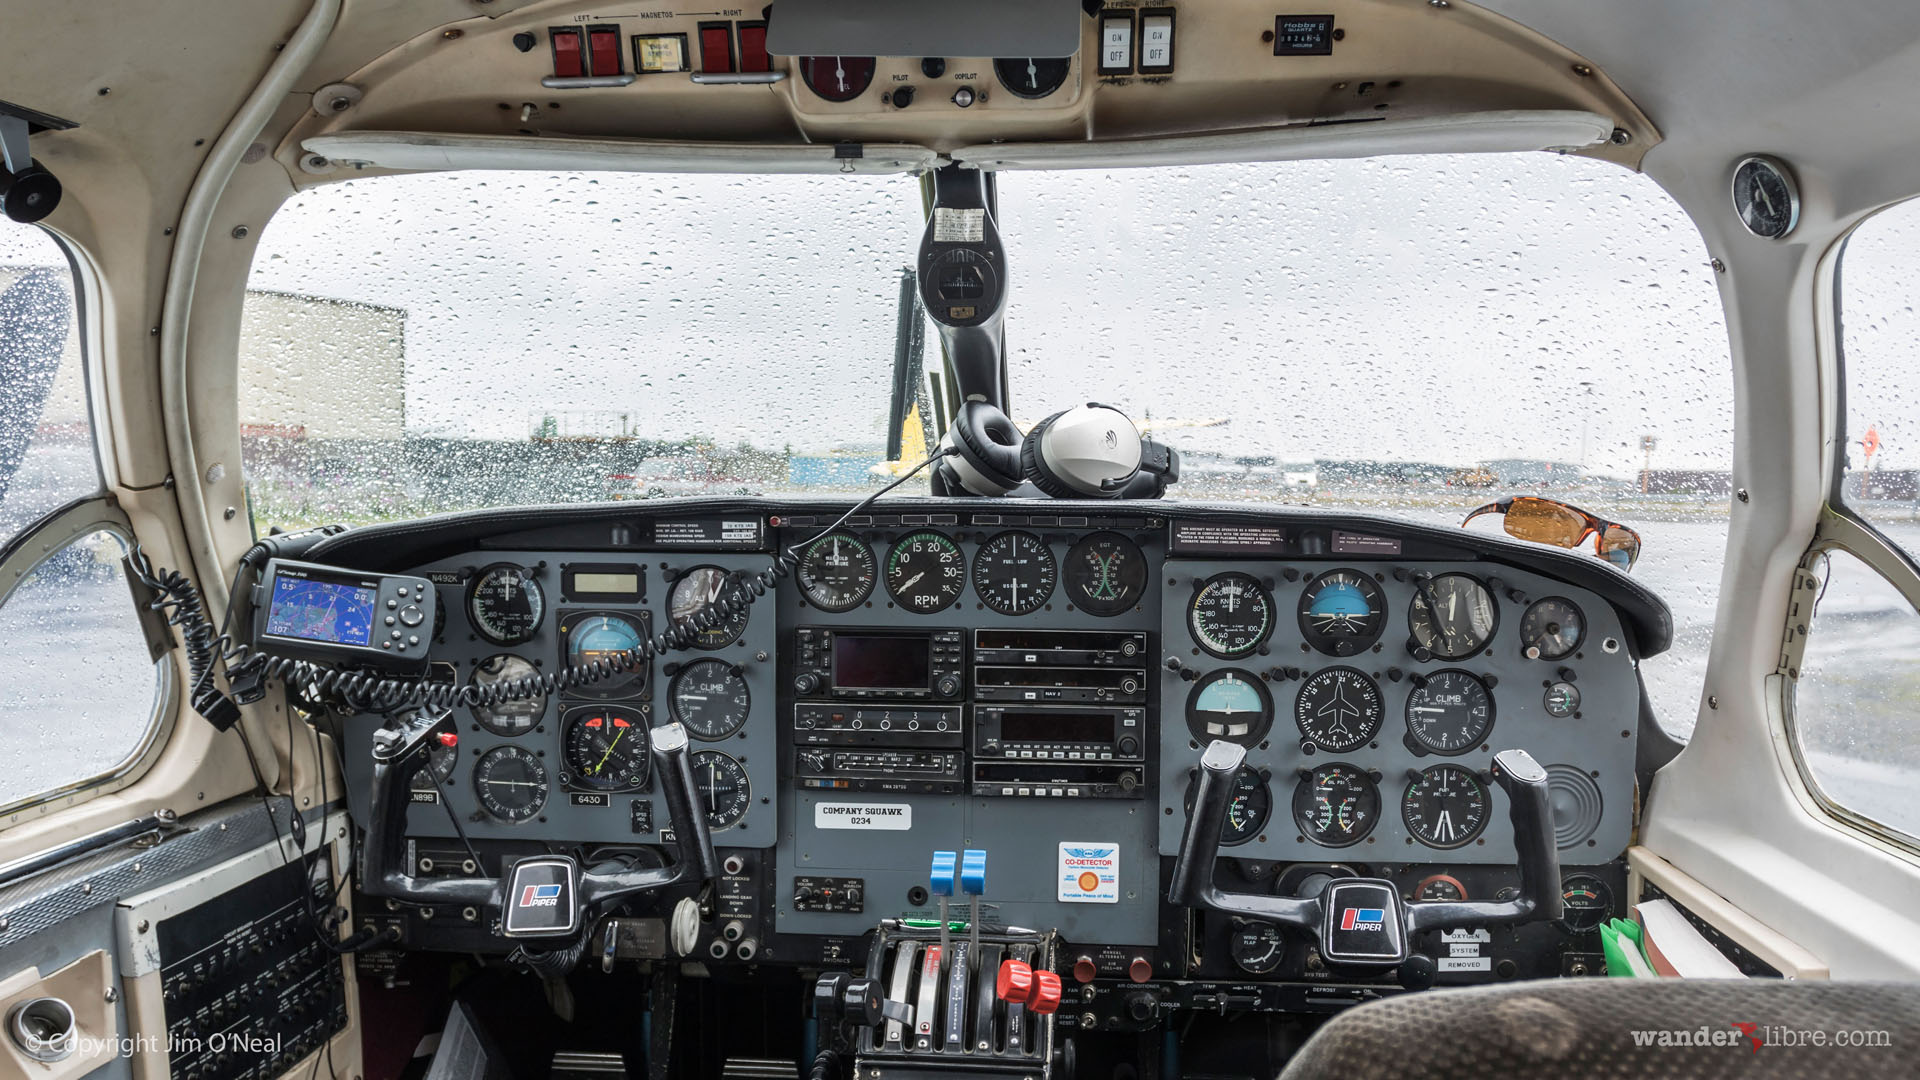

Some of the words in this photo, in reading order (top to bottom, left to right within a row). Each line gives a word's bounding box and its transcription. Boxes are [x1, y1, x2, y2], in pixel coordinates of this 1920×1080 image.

[723, 9, 742, 17] RIGHT
[1112, 33, 1122, 42] ON
[1152, 31, 1163, 40] ON
[1110, 51, 1123, 62] OFF
[1150, 49, 1162, 60] OFF
[913, 543, 922, 552] 15
[928, 543, 940, 552] 20
[900, 554, 910, 562] 10
[940, 553, 952, 563] 25
[895, 568, 902, 576] 5
[944, 568, 956, 577] 30
[1449, 578, 1455, 586] 0
[685, 590, 690, 598] 8
[915, 596, 939, 605] RPM
[1416, 602, 1421, 610] 8
[273, 625, 287, 633] 107
[1415, 622, 1421, 630] 7
[1463, 687, 1469, 695] 3
[1436, 695, 1462, 703] CLIMB
[1306, 702, 1312, 710] 12
[857, 711, 862, 719] 0
[885, 711, 889, 719] 2
[942, 712, 946, 720] 4
[1461, 727, 1467, 735] 3
[578, 796, 601, 804] 6430
[823, 807, 862, 815] COMPANY
[865, 808, 903, 816] SQUAWK
[851, 817, 871, 825] 0234
[1355, 923, 1382, 931] PIPER
